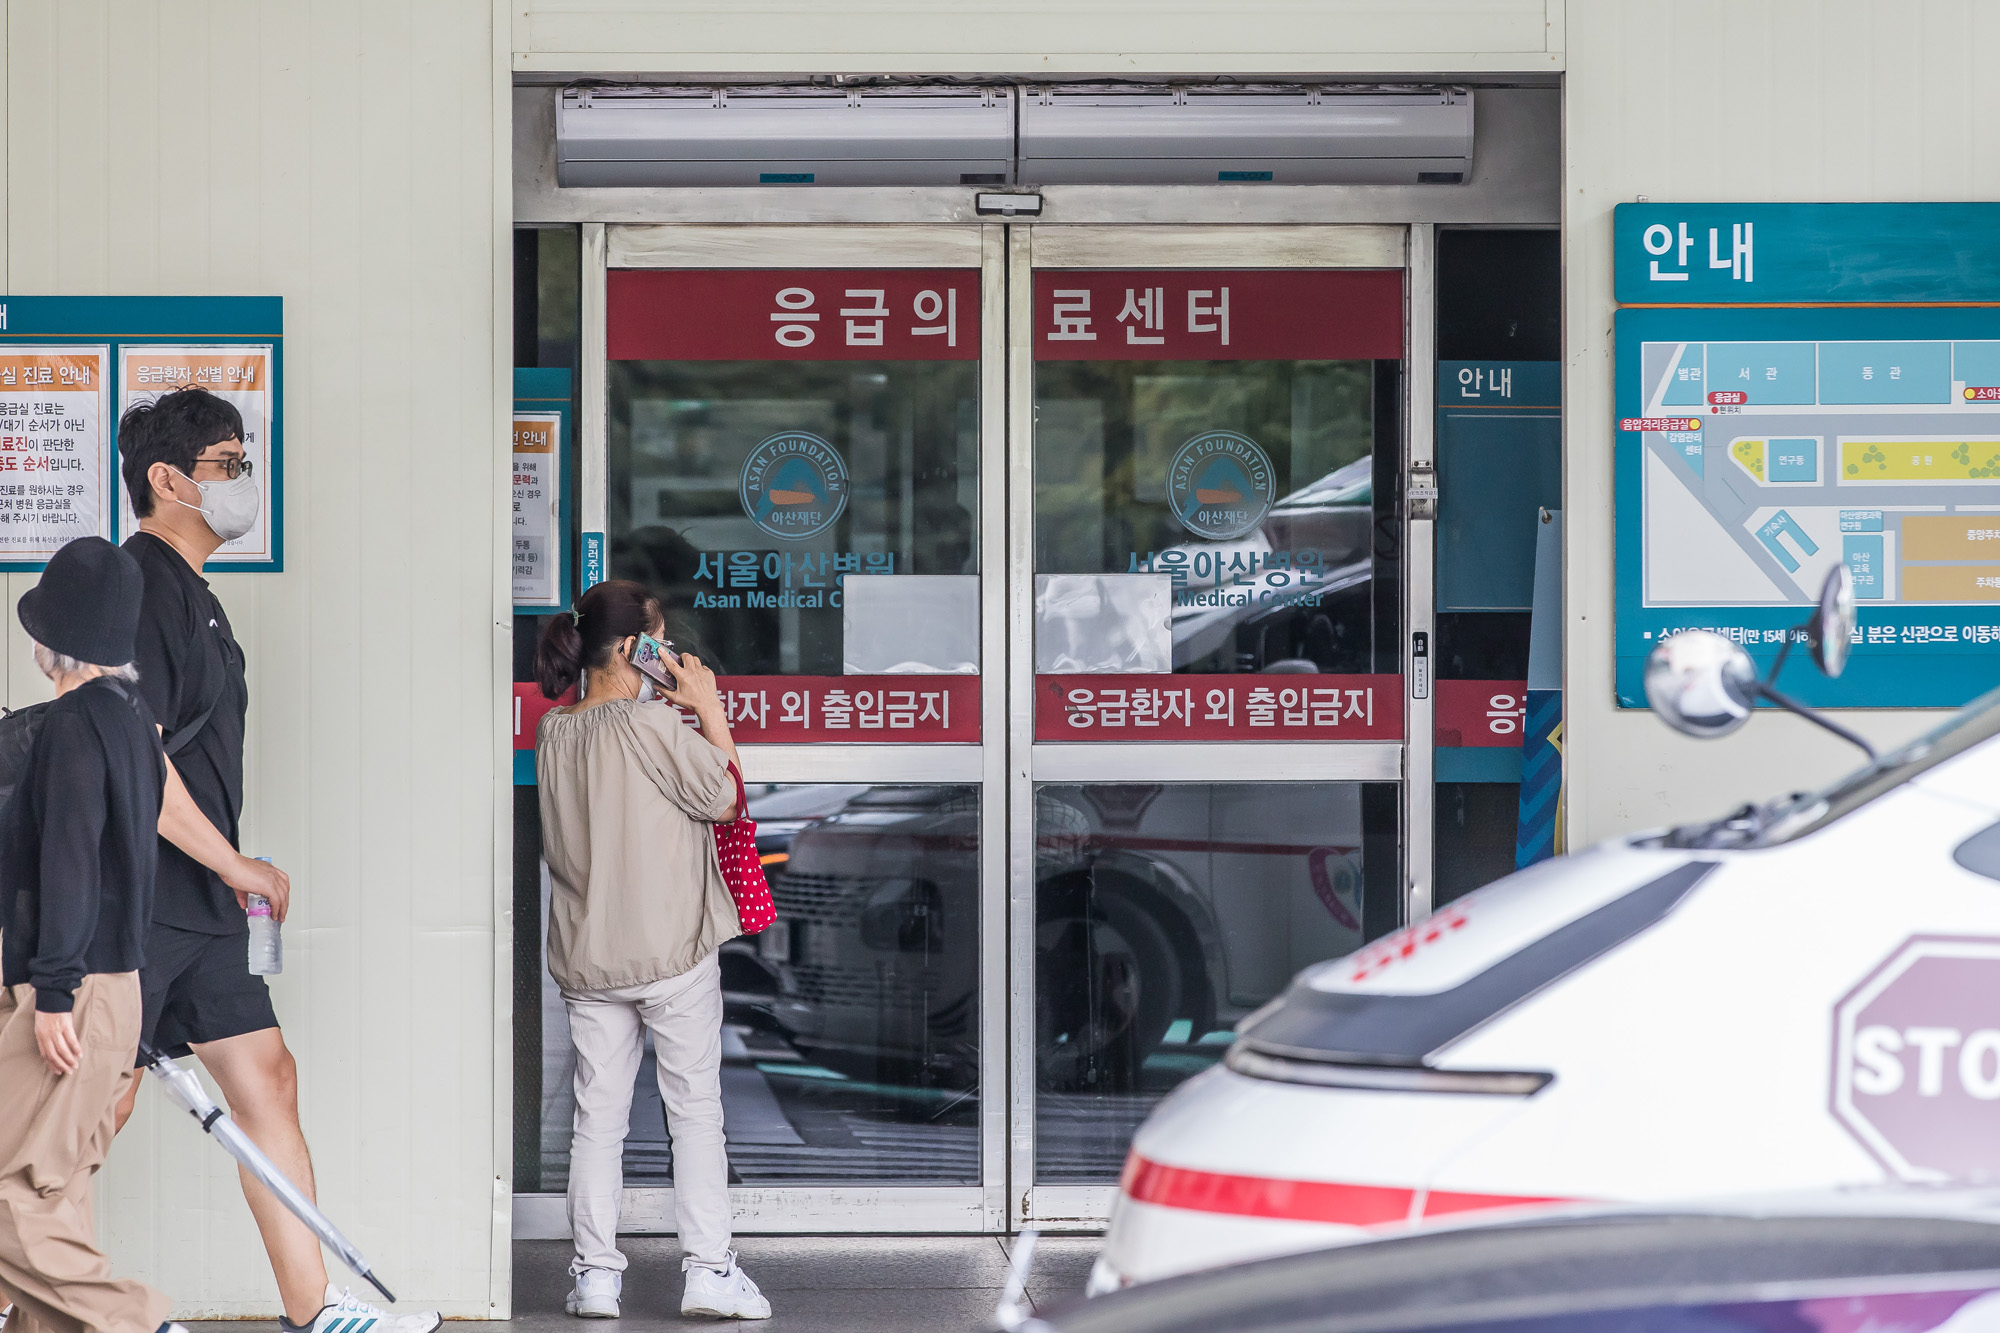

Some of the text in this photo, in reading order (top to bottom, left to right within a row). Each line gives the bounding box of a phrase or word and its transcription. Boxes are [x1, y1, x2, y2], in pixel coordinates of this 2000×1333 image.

[1642, 222, 1754, 282] 안내
[0, 366, 90, 385] 실 진료 안내
[136, 365, 254, 383] 응급환자 선별 안내
[1678, 366, 1702, 381] 별관
[1458, 367, 1511, 398] 안내
[1714, 392, 1741, 404] 응급실
[1976, 387, 2000, 400] 소아
[33, 402, 65, 416] 진료는
[28, 418, 60, 432] 순서가
[63, 418, 85, 432] 아닌
[0, 435, 75, 452] 료진이 판단한
[522, 430, 547, 446] 안내
[22, 455, 84, 472] 순서입니다.
[748, 439, 840, 491] ASAN FOUNDATION
[1175, 438, 1266, 490] ASAN FOUNDATION
[29, 485, 63, 496] 원하시는
[67, 485, 84, 496] 경우
[16, 499, 33, 510] 병원
[36, 499, 71, 510] 응급실을
[13, 513, 39, 524] 주시기
[42, 513, 80, 524] 바랍니다.
[771, 511, 822, 526] 아산재단
[1198, 510, 1248, 525] 아산재단
[693, 591, 740, 608] Asan
[748, 590, 823, 608] Medical
[1177, 590, 1324, 607] Medical Center
[1867, 626, 1897, 644] 분은
[1900, 626, 1959, 644] 신관으로
[779, 690, 810, 729] 외
[821, 689, 949, 729] 출입금지
[1065, 687, 1373, 729] 응급환자 외 출입금지
[1486, 694, 1527, 734] 응
